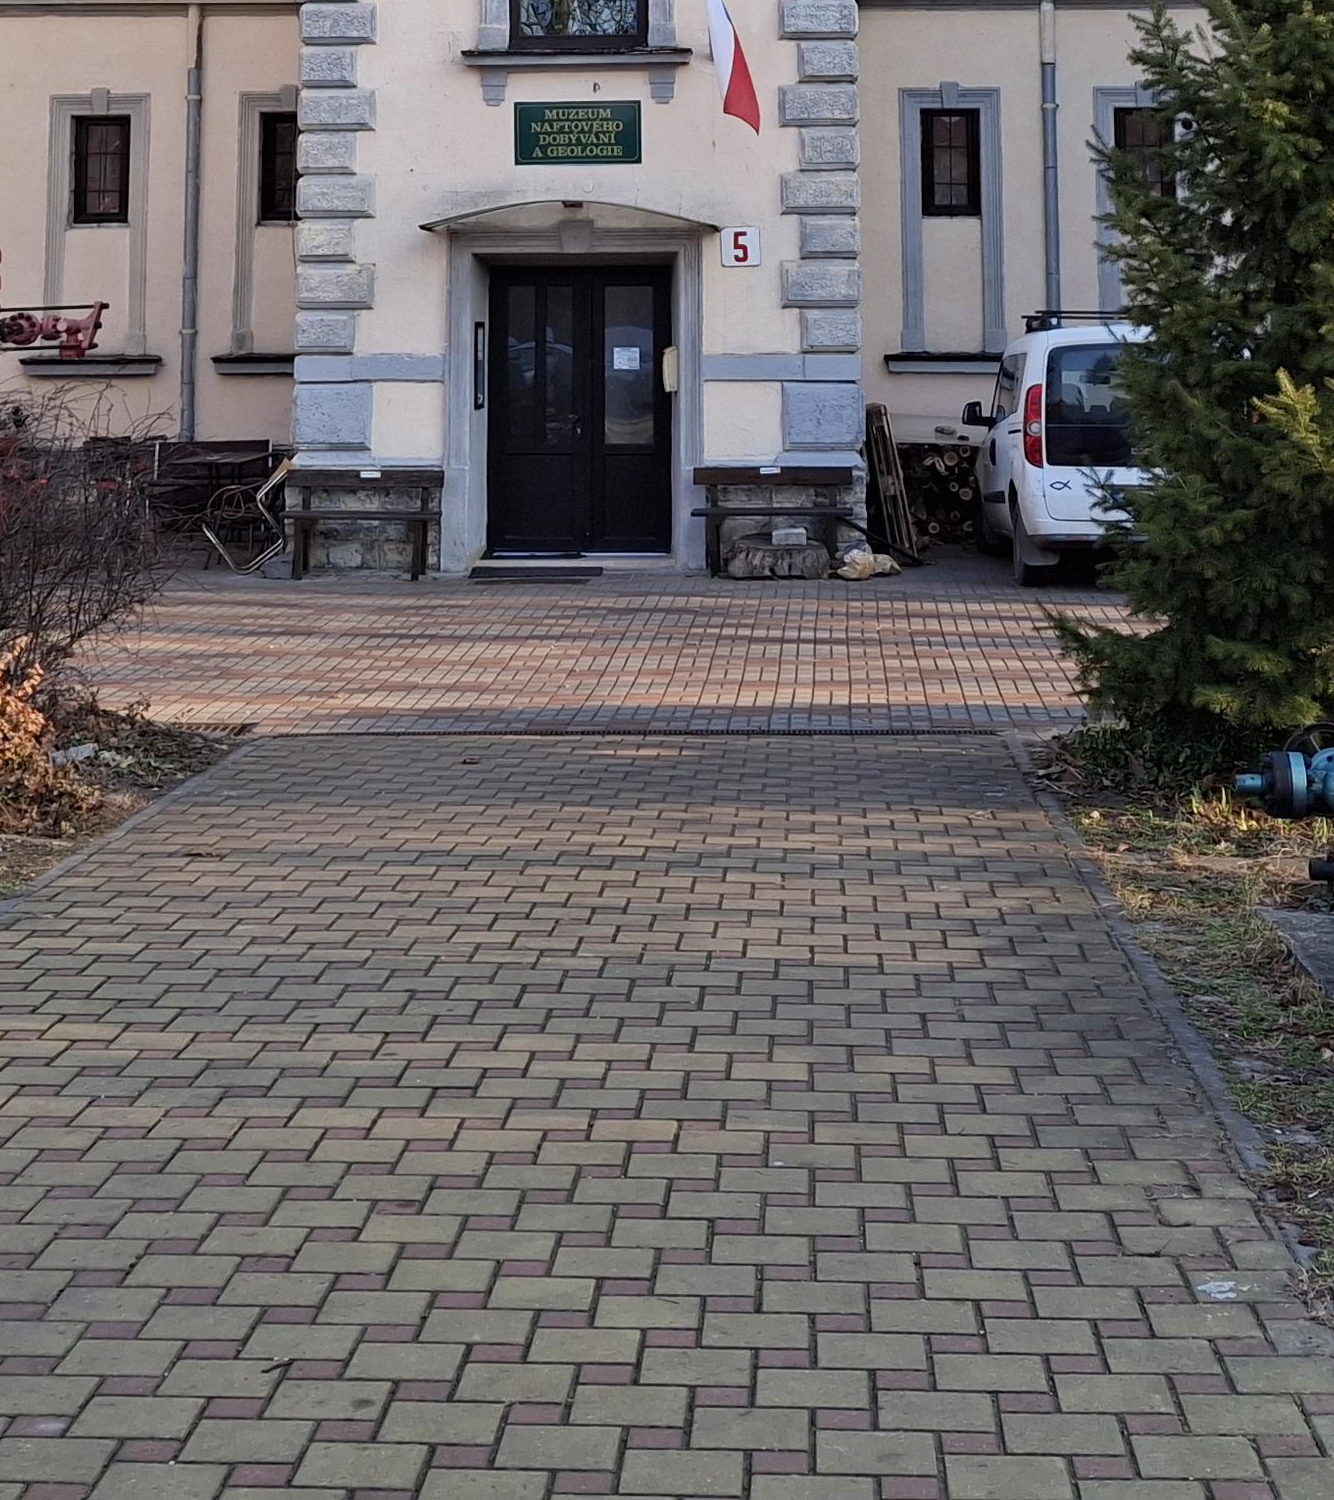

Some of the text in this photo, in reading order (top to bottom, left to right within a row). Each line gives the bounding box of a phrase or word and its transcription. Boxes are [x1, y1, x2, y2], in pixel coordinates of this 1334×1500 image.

[544, 108, 612, 120] MUZEUM
[530, 118, 624, 133] NAFTOVÉHO
[538, 130, 617, 145] DOBÝVÁNÍ
[531, 145, 624, 158] A GEOLOGIE
[733, 231, 749, 263] 5
